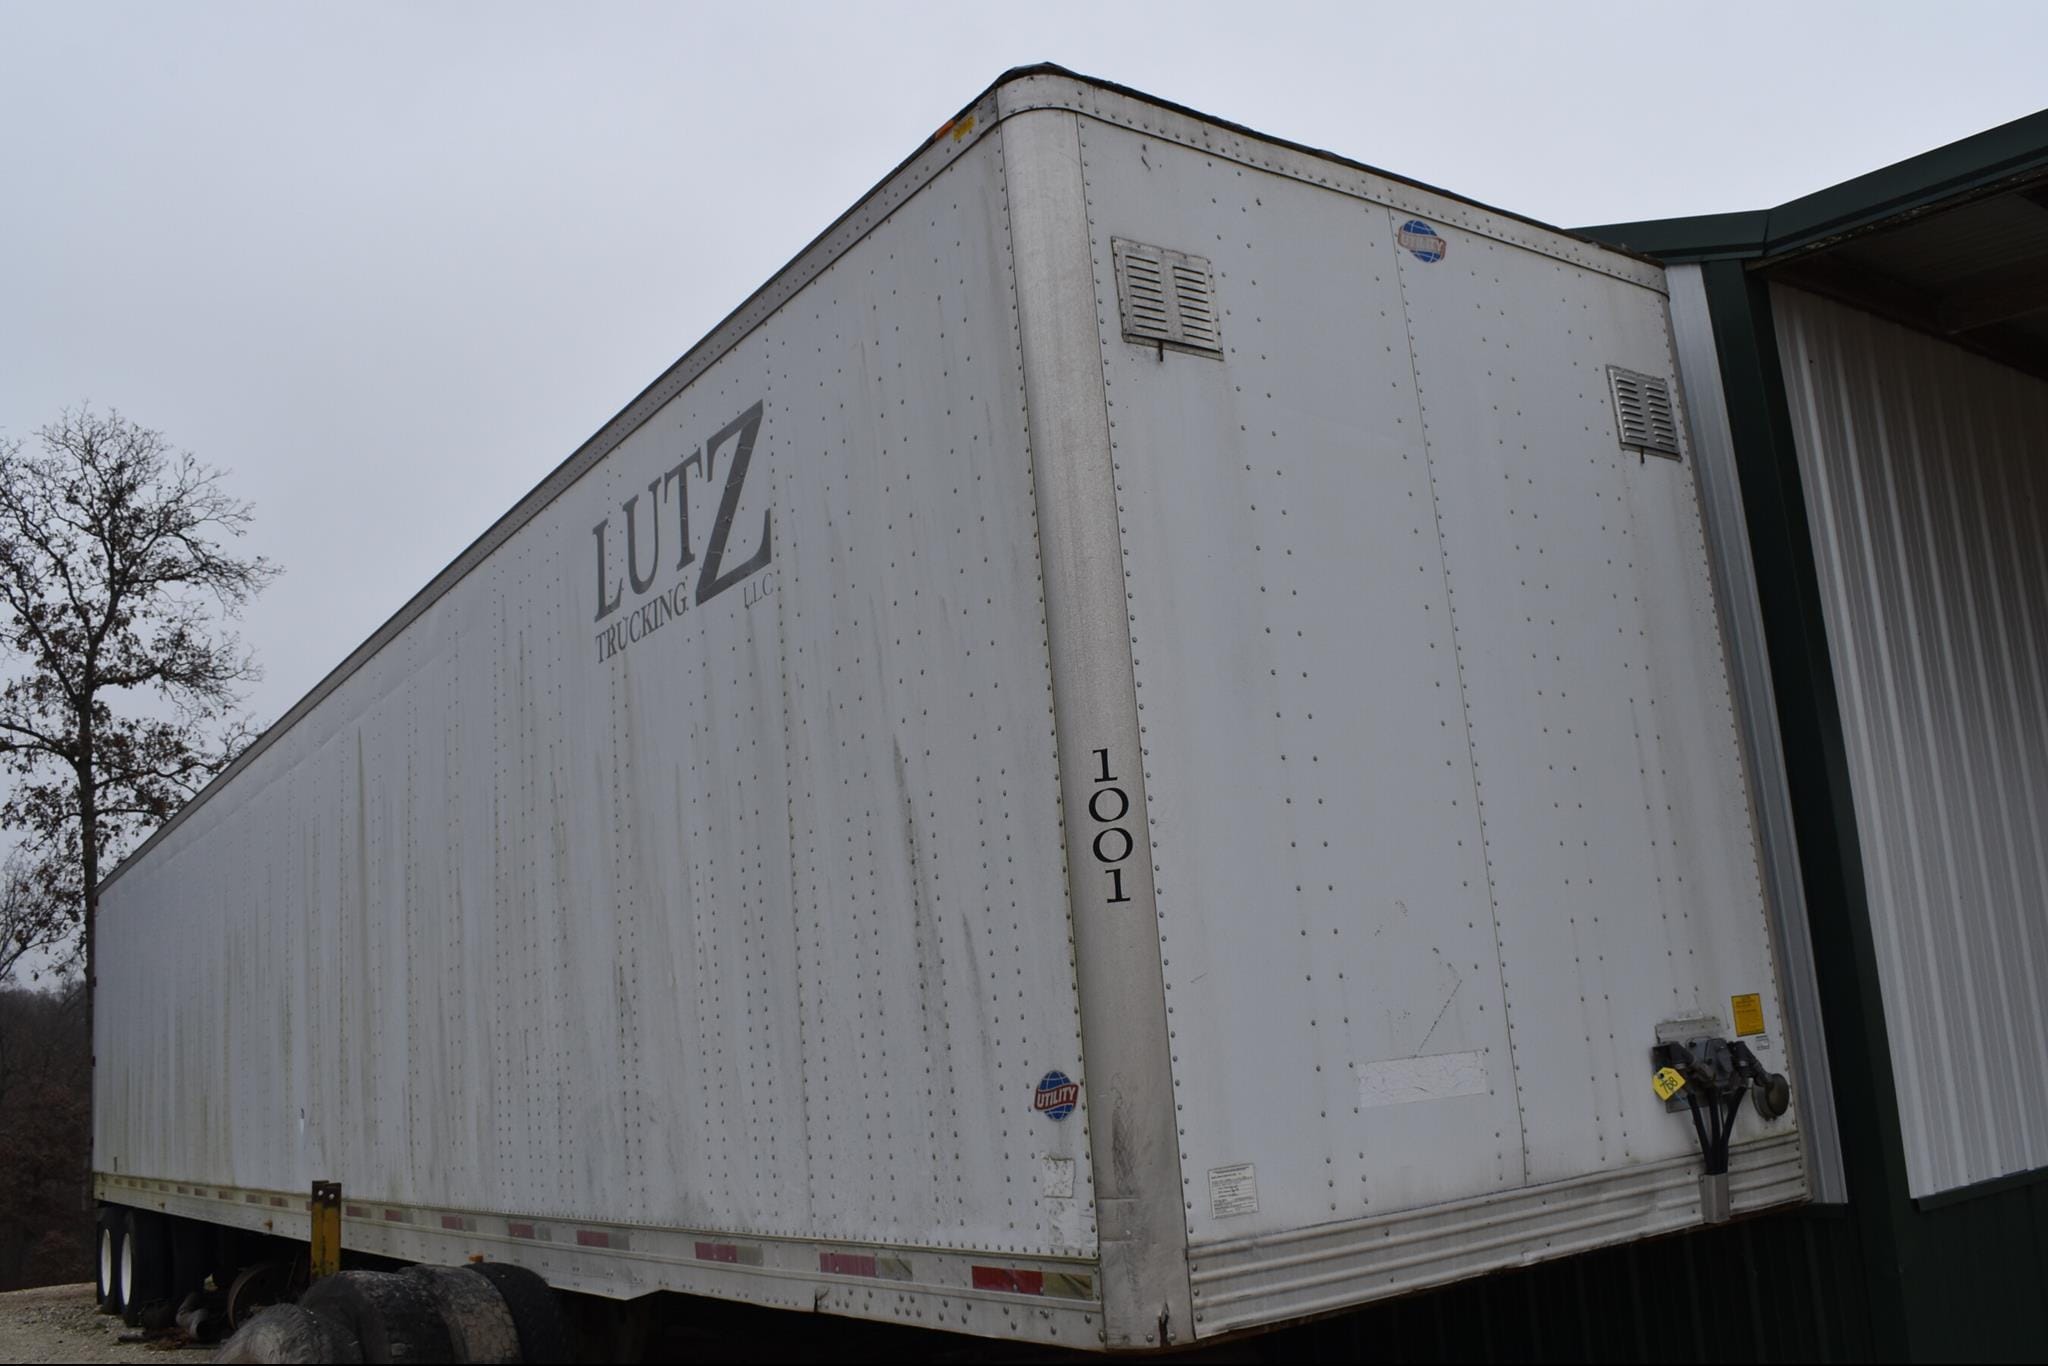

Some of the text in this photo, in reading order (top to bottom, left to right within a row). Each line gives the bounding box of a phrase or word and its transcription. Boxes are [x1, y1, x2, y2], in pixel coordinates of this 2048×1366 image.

[592, 399, 771, 622] LUTZ
[595, 582, 688, 664] TRUCKING
[743, 572, 774, 609] LLC
[1088, 747, 1133, 904] 1001
[1037, 1086, 1076, 1108] UTILITY
